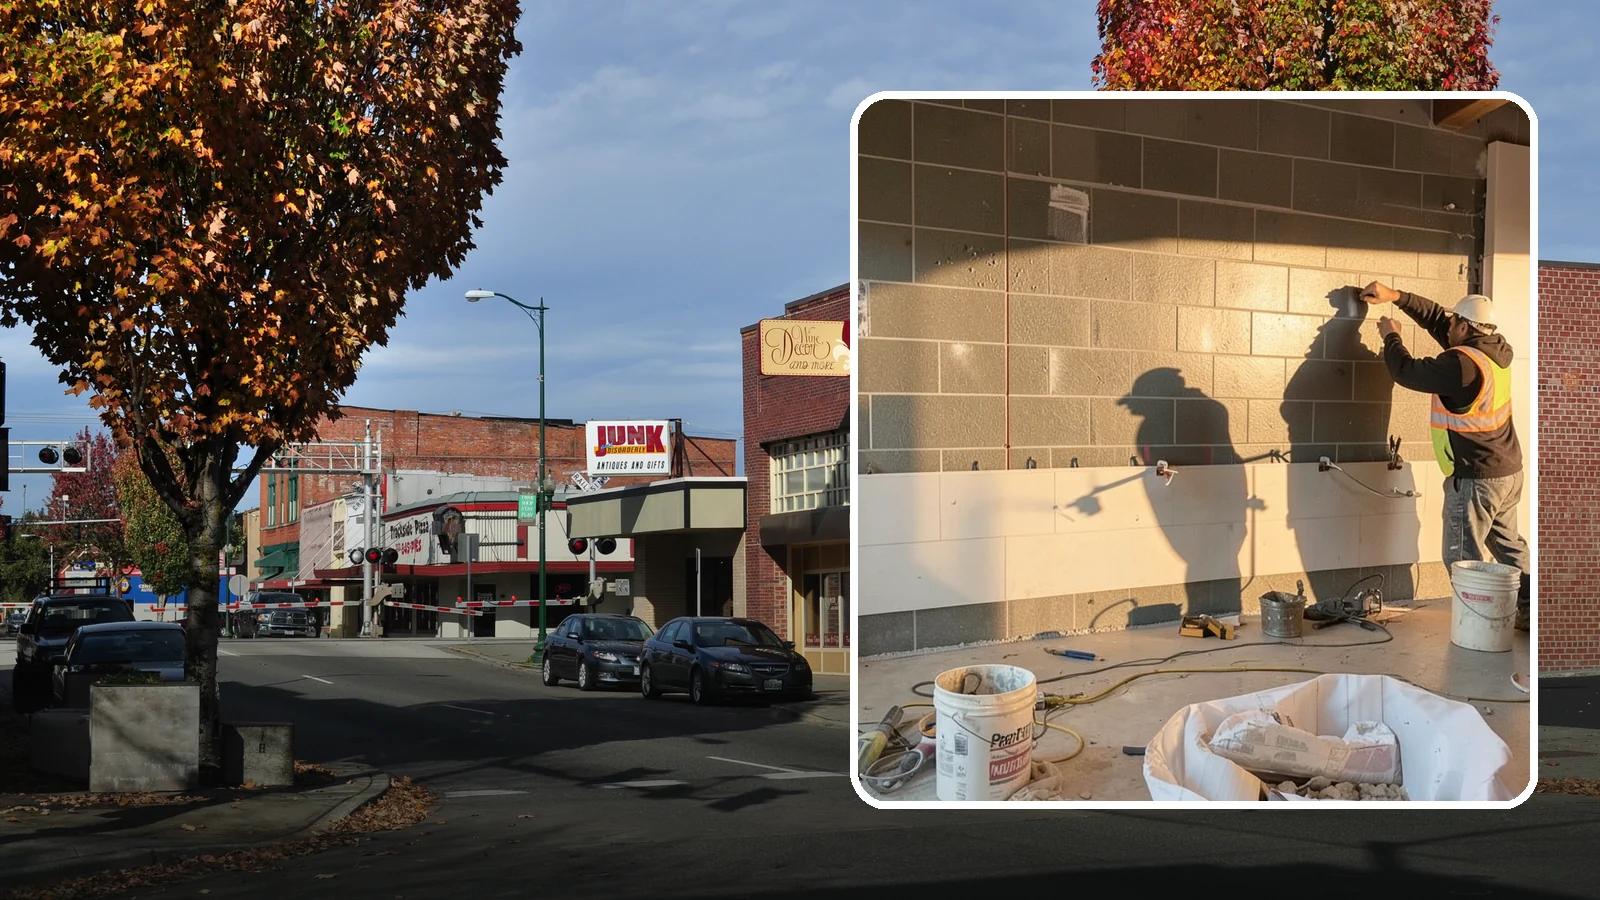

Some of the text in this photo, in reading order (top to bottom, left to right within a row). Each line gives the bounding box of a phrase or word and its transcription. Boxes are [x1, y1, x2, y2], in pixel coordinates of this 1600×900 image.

[811, 361, 835, 370] MORE
[595, 425, 665, 457] JUNK
[607, 446, 646, 454] DISORDERLY
[597, 461, 665, 470] ANTIQUES AND GIFTS
[390, 519, 429, 540] Trackside Pizza
